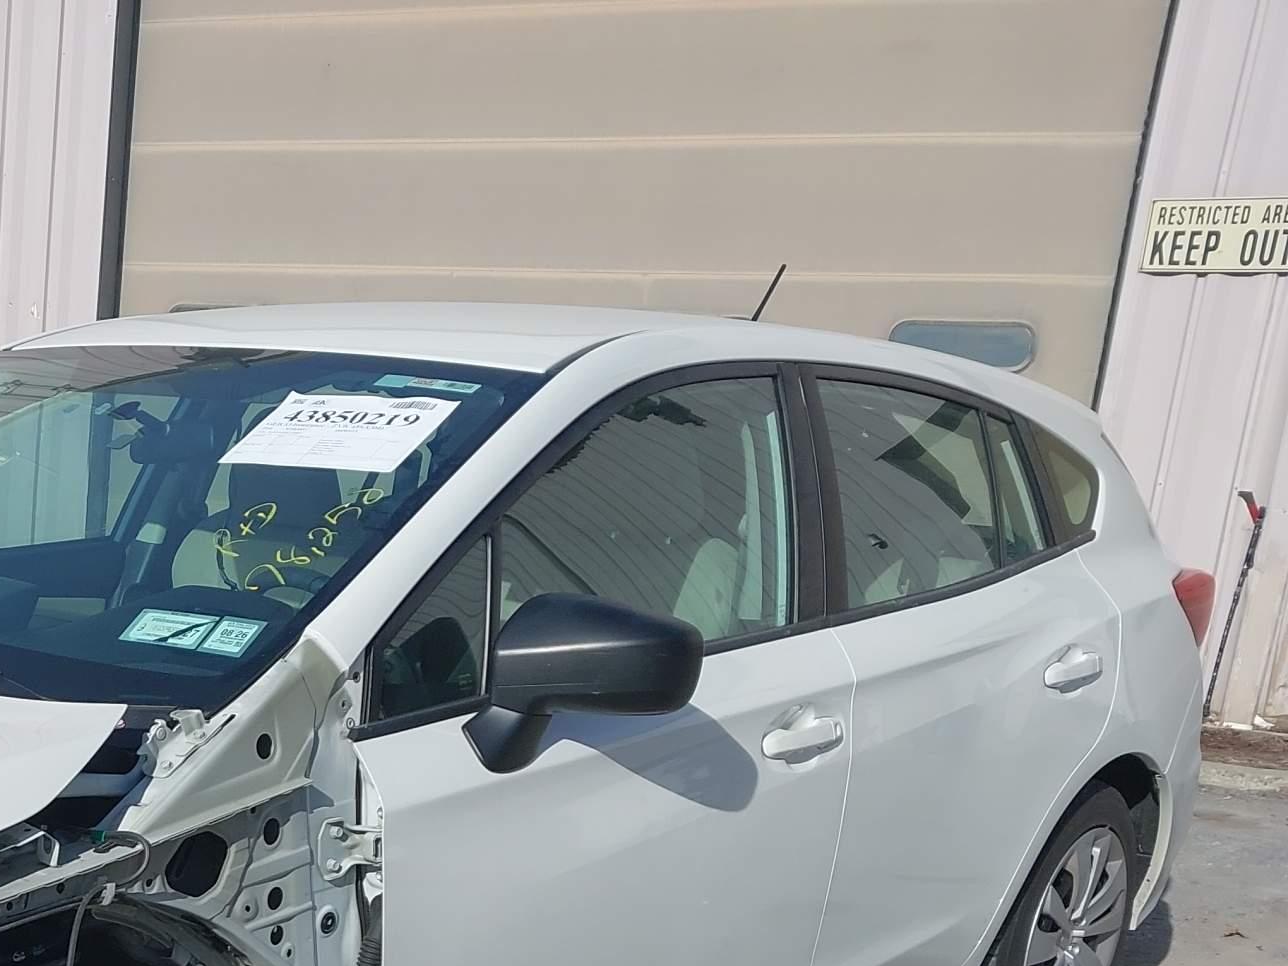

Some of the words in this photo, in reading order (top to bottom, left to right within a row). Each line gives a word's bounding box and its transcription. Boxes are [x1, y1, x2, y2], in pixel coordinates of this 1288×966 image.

[1157, 205, 1251, 225] RESTRICTED
[1149, 230, 1222, 266] KEEP
[284, 409, 421, 427] 43850219
[220, 628, 233, 637] 08
[234, 630, 248, 639] 26
